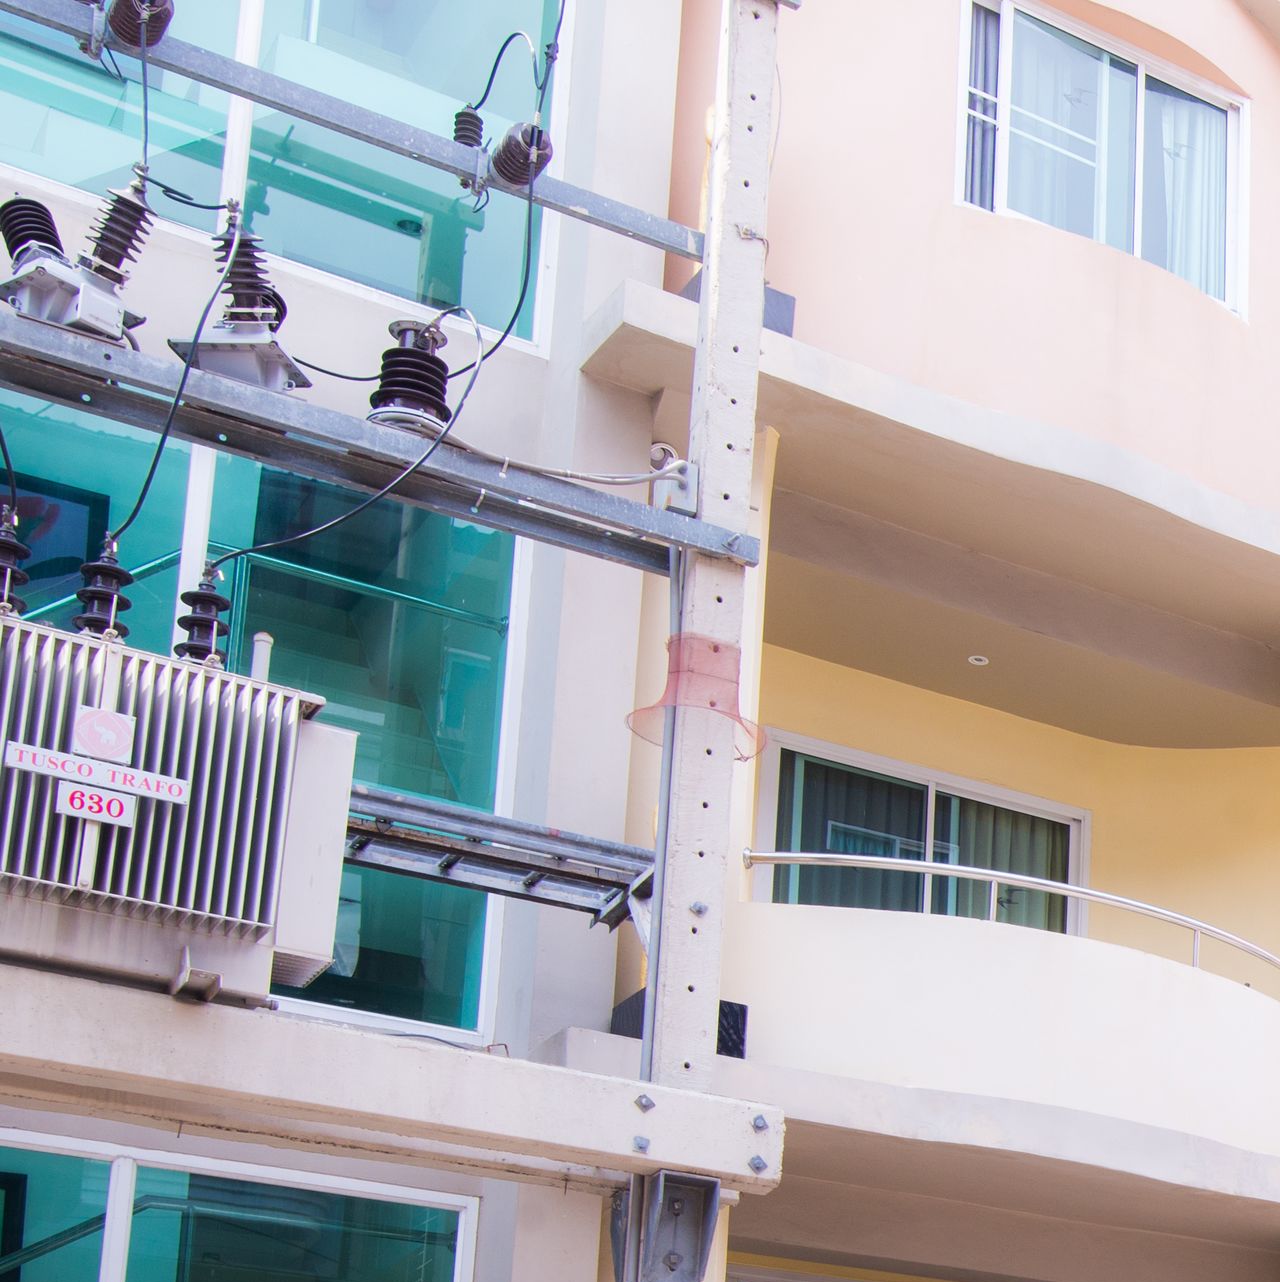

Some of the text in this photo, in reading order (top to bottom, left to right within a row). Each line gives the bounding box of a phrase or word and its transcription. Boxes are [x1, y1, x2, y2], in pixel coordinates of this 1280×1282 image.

[14, 747, 184, 798] TUSCO TRAFO
[68, 789, 125, 819] 630
